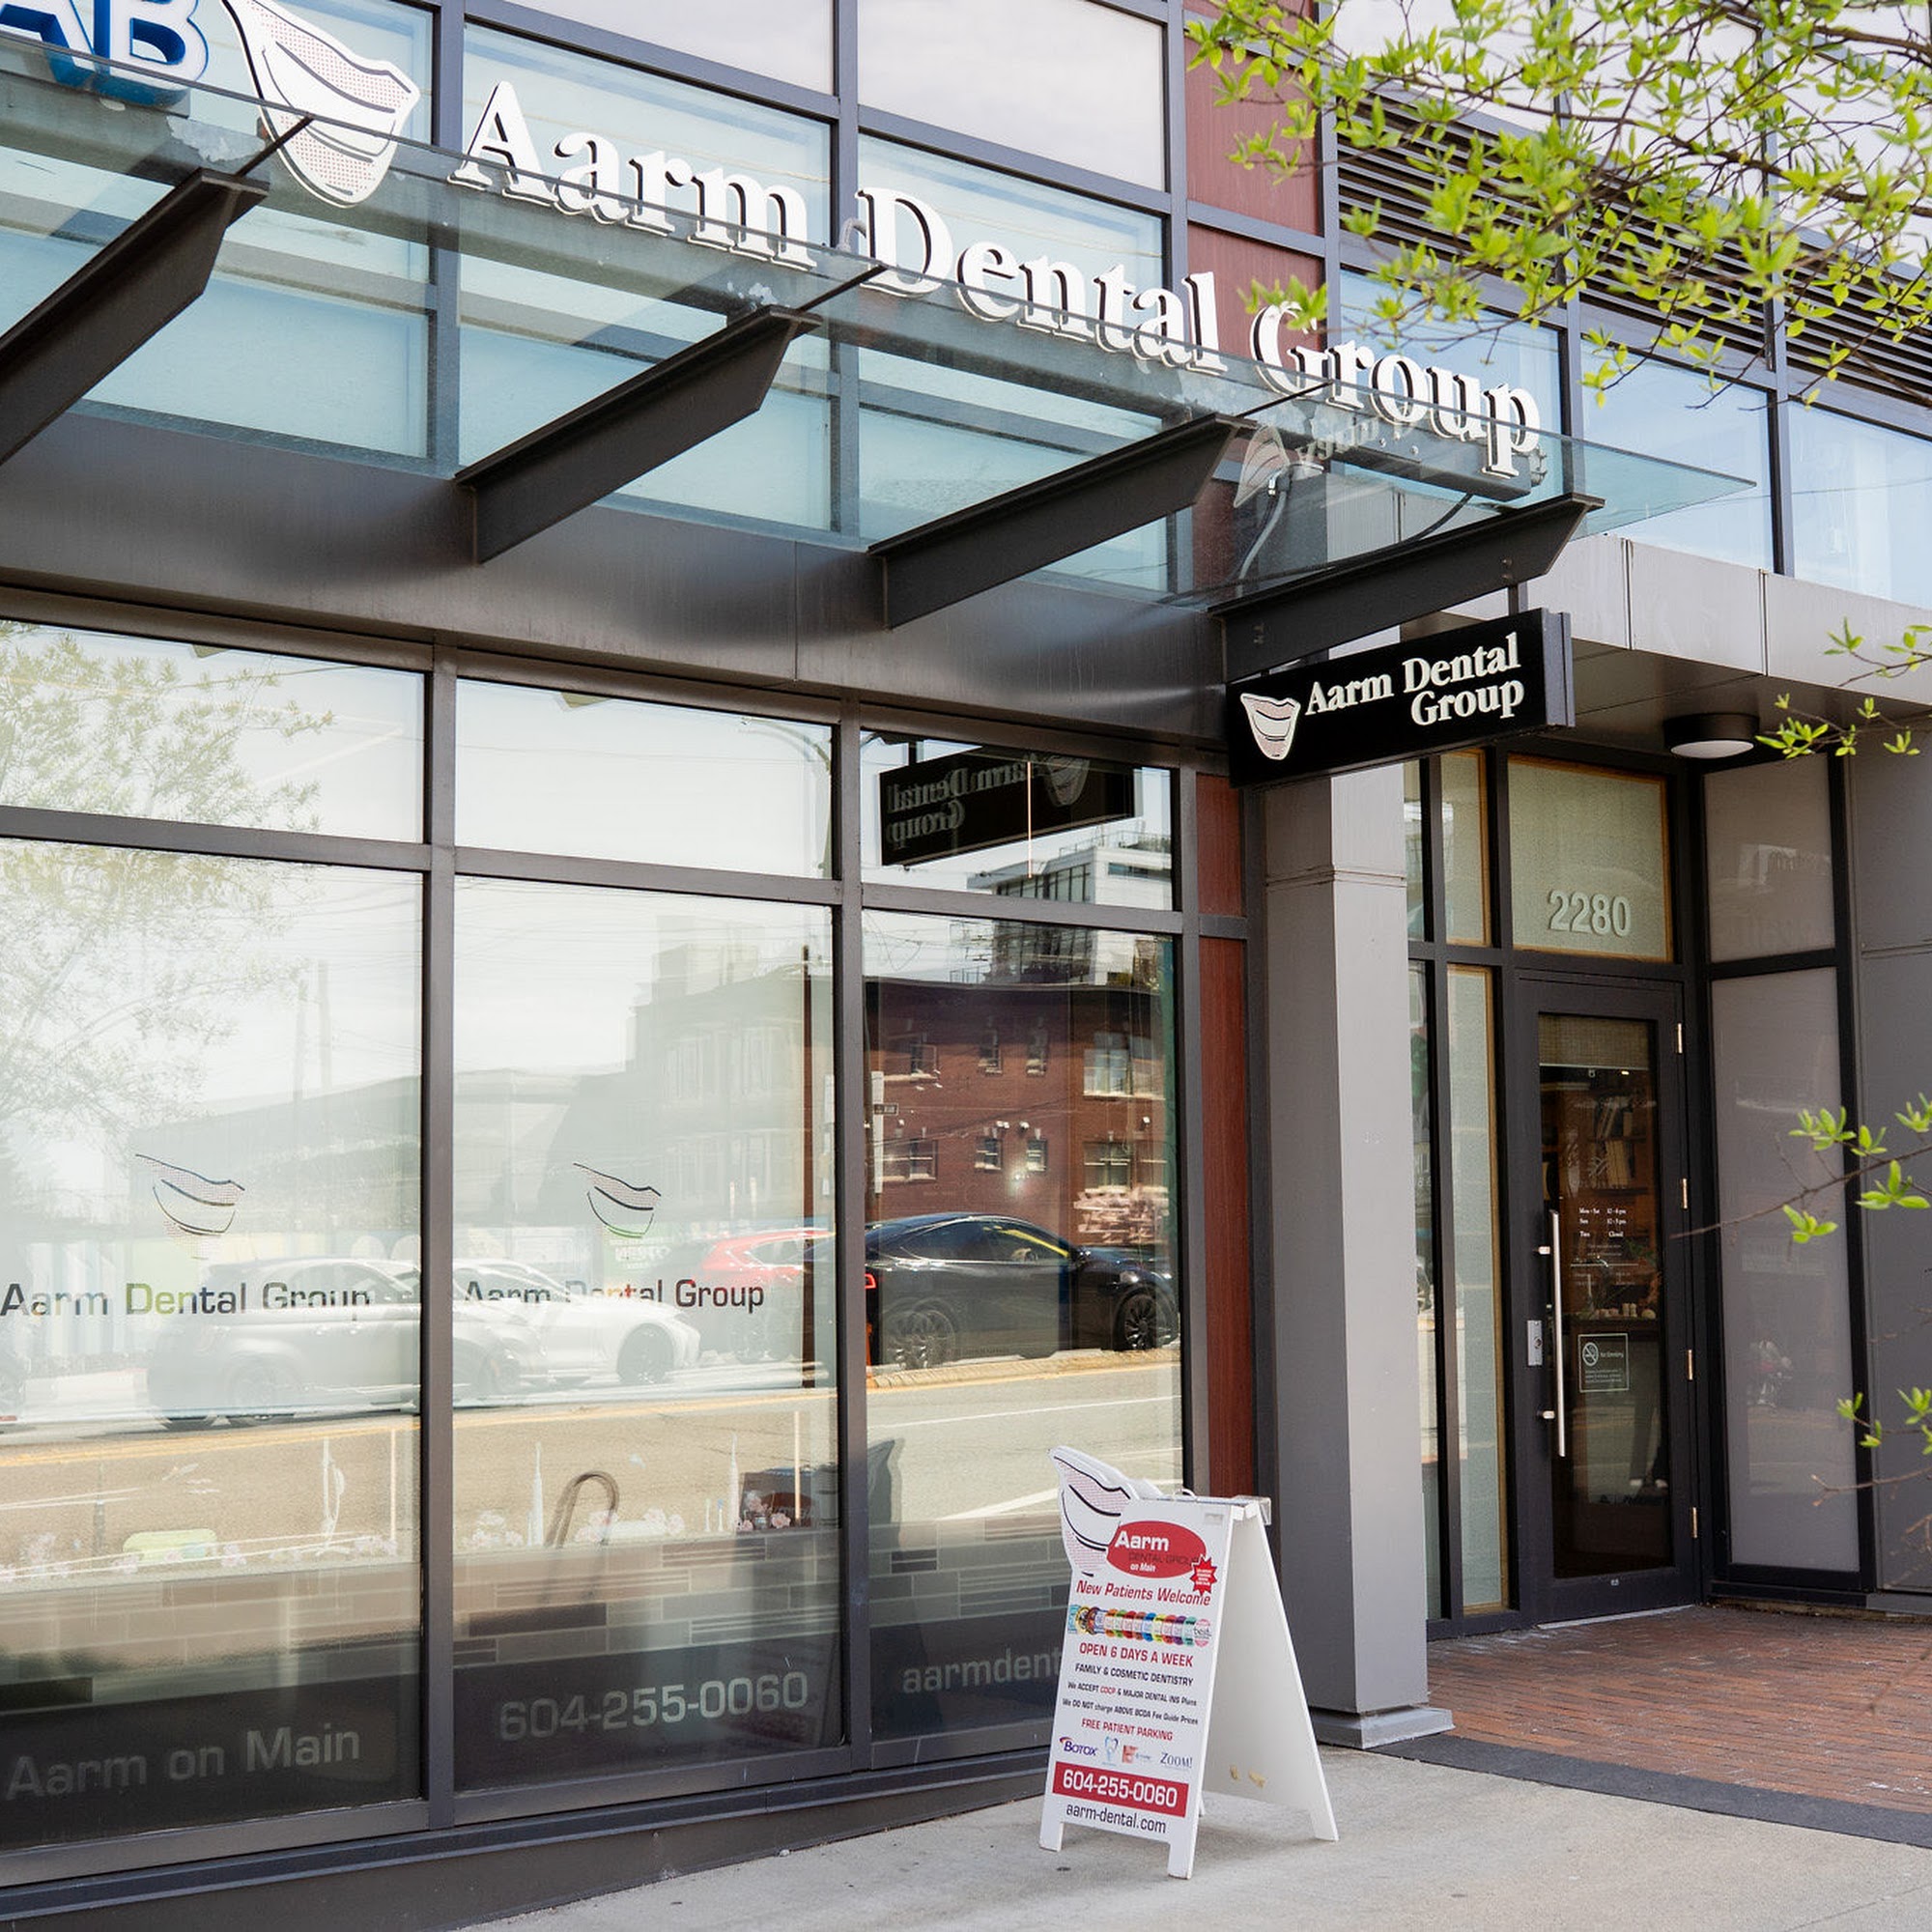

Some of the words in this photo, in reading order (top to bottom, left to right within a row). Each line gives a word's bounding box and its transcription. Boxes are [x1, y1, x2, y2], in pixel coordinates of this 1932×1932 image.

[446, 80, 817, 272] Aarm
[856, 187, 1229, 376] Dental
[1250, 300, 1541, 480] Group
[1305, 673, 1395, 716] Aarm
[1402, 631, 1521, 694] Dental
[1411, 679, 1524, 726] Group
[1548, 890, 1632, 937] 2280
[0, 1283, 109, 1317] Aarm
[126, 1283, 246, 1317] Dental
[675, 1279, 764, 1314] Group
[1114, 1530, 1170, 1552] Aarm
[1130, 1563, 1139, 1572] on
[1140, 1562, 1156, 1573] Main
[1076, 1579, 1101, 1595] New
[1104, 1582, 1153, 1601] Patients
[1157, 1587, 1211, 1606] Welcome
[1079, 1642, 1107, 1658] OPEN
[1111, 1646, 1118, 1658] 6
[1120, 1647, 1148, 1662] DAYS
[1151, 1651, 1159, 1663] A
[1161, 1652, 1194, 1668] WEEK
[1075, 1662, 1102, 1675] FAMILY
[1103, 1665, 1109, 1675] &
[1110, 1667, 1149, 1682] COSMETIC
[1151, 1671, 1194, 1687] DENTISTRY
[499, 1671, 809, 1740] 604-255-0060
[1072, 1699, 1081, 1708] DO
[1082, 1700, 1094, 1709] NOT
[1114, 1706, 1134, 1716] ABOVE
[1077, 1683, 1099, 1691] ACCEPT
[1122, 1689, 1144, 1698] MAJOR
[1145, 1691, 1167, 1702] DENTAL
[1082, 1718, 1100, 1730] FREE
[1103, 1720, 1135, 1735] PATIENT
[1137, 1726, 1174, 1742] PARKING
[6, 1753, 147, 1801] Aarm
[169, 1746, 225, 1780] on
[246, 1723, 359, 1773] Main
[1063, 1769, 1178, 1807] 604-255-0060
[1065, 1803, 1167, 1833] aarm-dental.com
